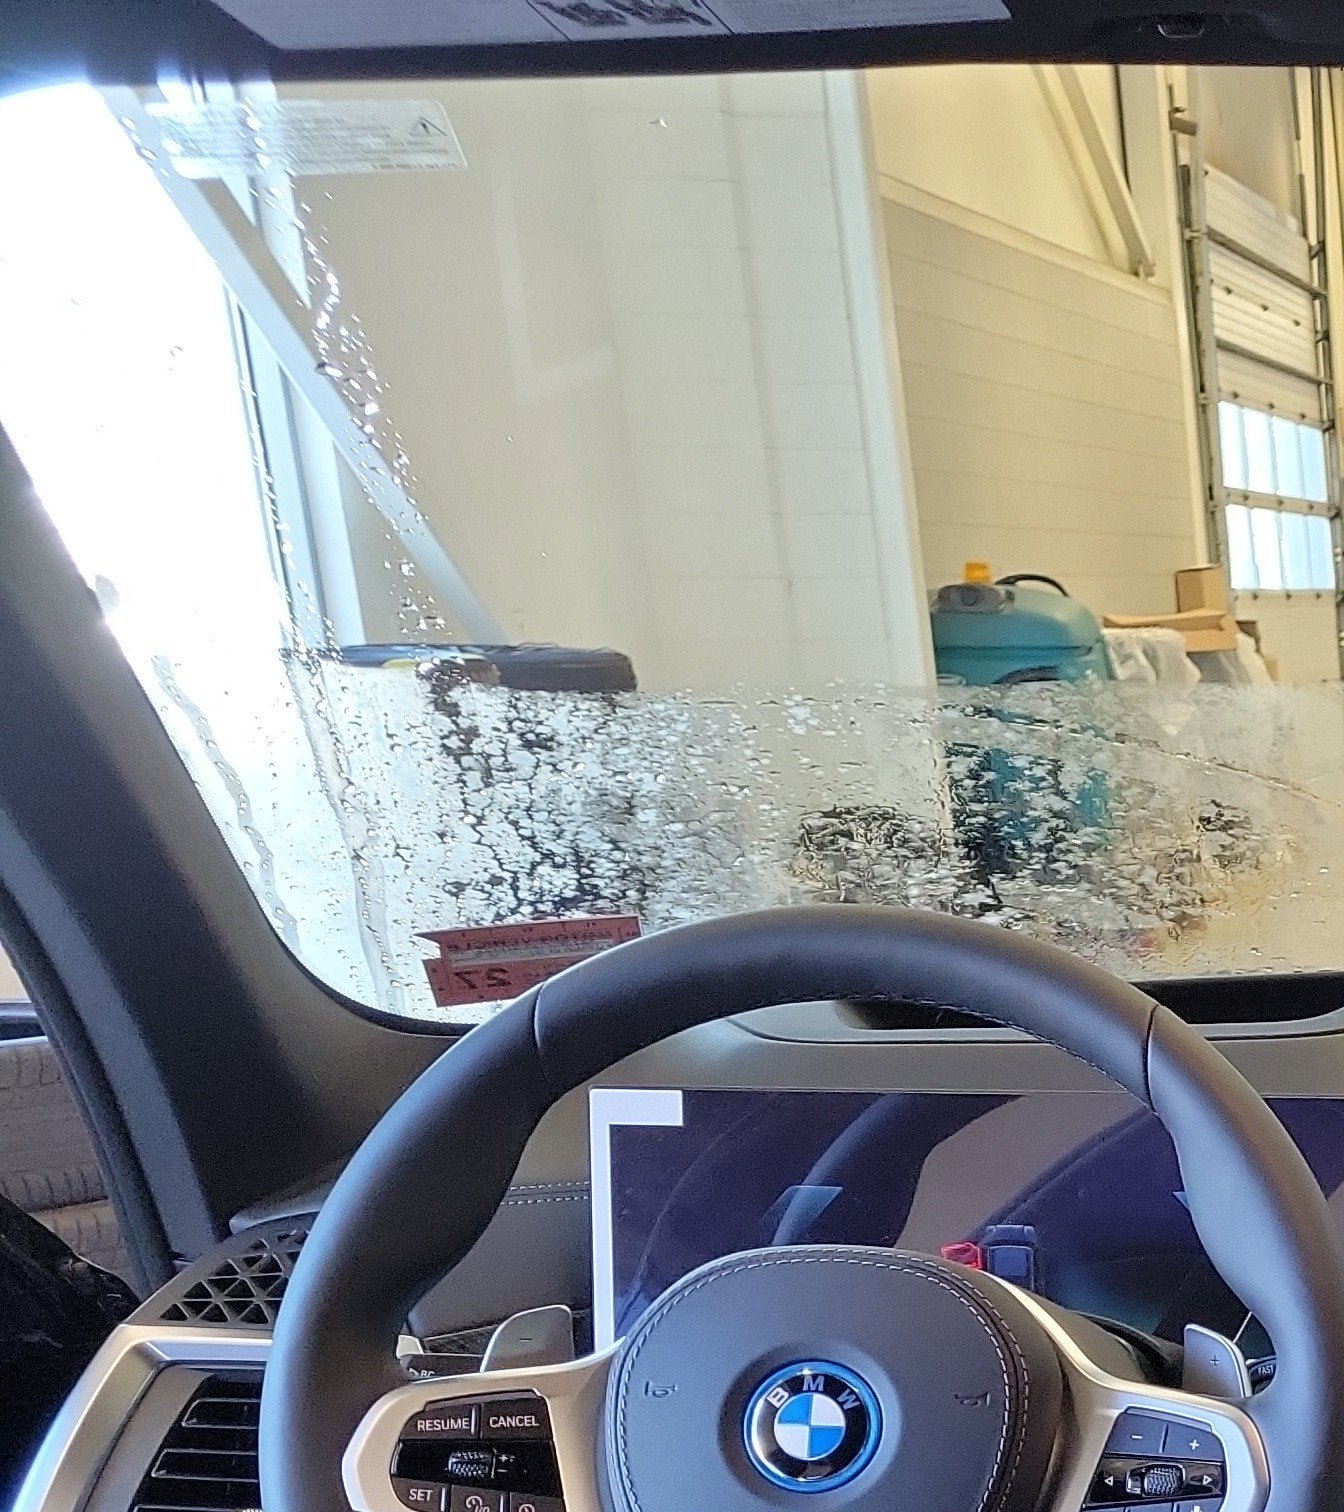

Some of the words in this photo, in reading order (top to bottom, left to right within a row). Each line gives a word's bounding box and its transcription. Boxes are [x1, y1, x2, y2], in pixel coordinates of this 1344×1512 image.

[766, 1374, 861, 1411] BMW
[416, 1417, 471, 1432] RESUME
[488, 1414, 540, 1429] CANCEL
[408, 1489, 433, 1502] SET
